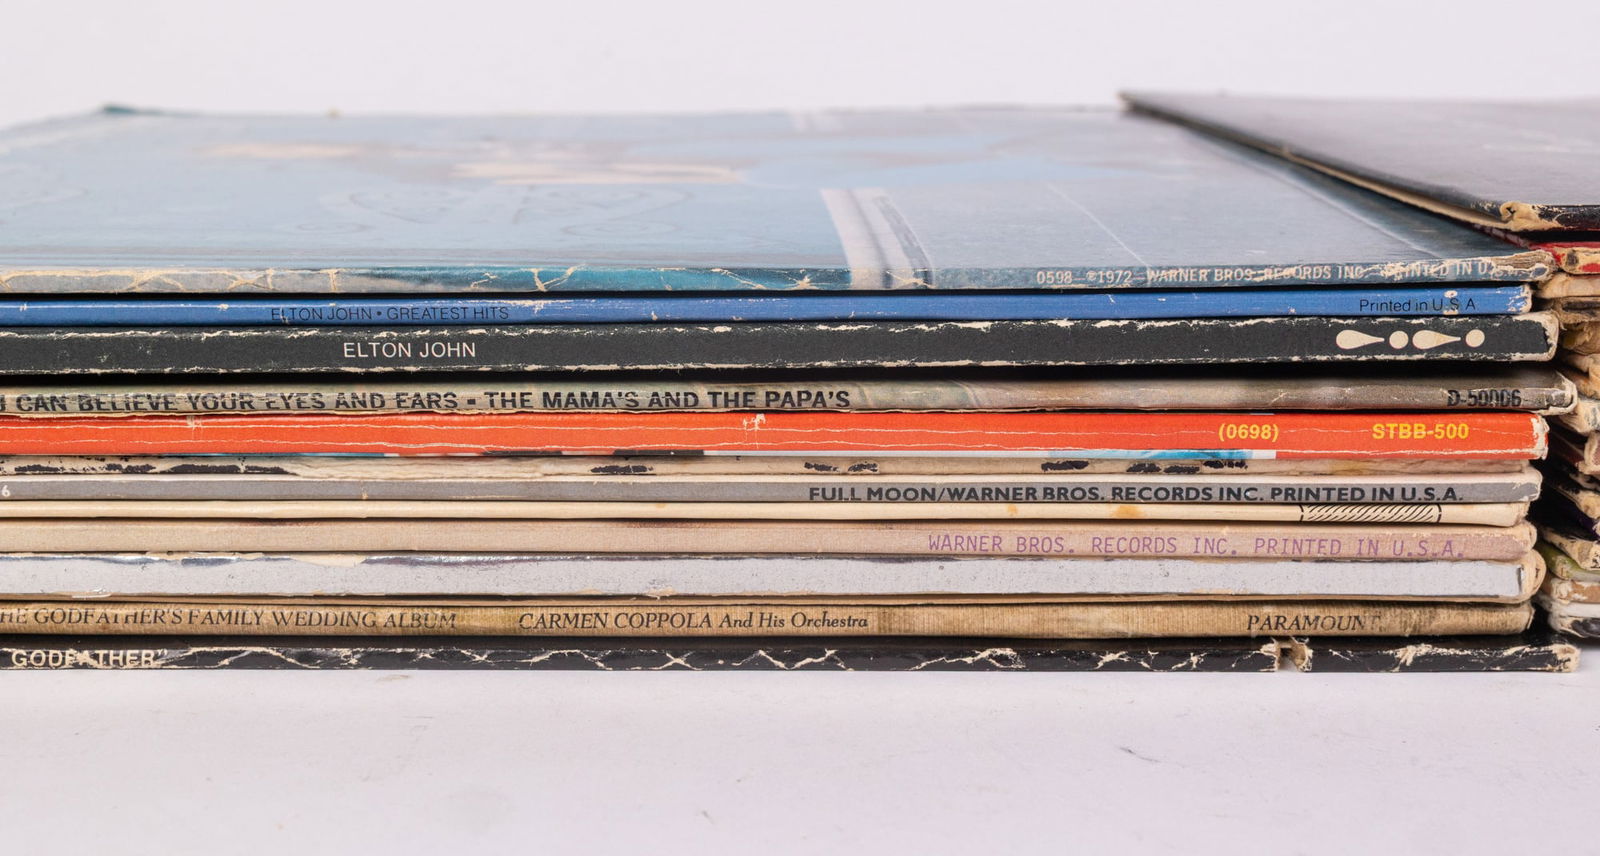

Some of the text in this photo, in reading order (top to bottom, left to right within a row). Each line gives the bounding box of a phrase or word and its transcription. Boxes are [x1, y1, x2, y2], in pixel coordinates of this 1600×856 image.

[1147, 268, 1208, 283] WARNER
[1455, 261, 1473, 275] IN
[271, 306, 509, 321] ELTON JOHN GREATEST HITS
[1359, 299, 1412, 312] Printed
[1415, 299, 1428, 312] in
[343, 342, 476, 358] ELTON JOHN
[16, 394, 67, 412] CAN
[78, 393, 177, 412] BELIEVE
[187, 392, 255, 411] YOUR
[265, 392, 326, 410] EYES
[335, 391, 386, 410] AND
[395, 391, 459, 410] EARS
[484, 391, 534, 409] THE
[542, 391, 640, 408] MAMA'S
[648, 390, 699, 408] AND
[707, 390, 756, 408] THE
[765, 390, 850, 408] PAPA'S
[1446, 389, 1521, 407] D-50006
[1218, 423, 1470, 442] (0698) STBB-500
[809, 487, 862, 501] FULL
[1042, 486, 1105, 501] BROS.
[1112, 486, 1213, 501] RECORDS
[1219, 487, 1265, 501] INC.
[1271, 487, 1366, 501] PRINTED
[1372, 487, 1395, 501] IN
[1401, 486, 1464, 502] U.S.A.
[928, 534, 1465, 557] WARNER BROS. RECORDS INC. PRINTED IN U.S.A.
[34, 607, 184, 625] GODFATHER'S
[188, 608, 264, 626] FAMILY
[272, 610, 377, 628] WEDDING
[383, 611, 457, 629] ALBUM
[518, 610, 868, 630] CARMEN COPPOLA And His Orchestra
